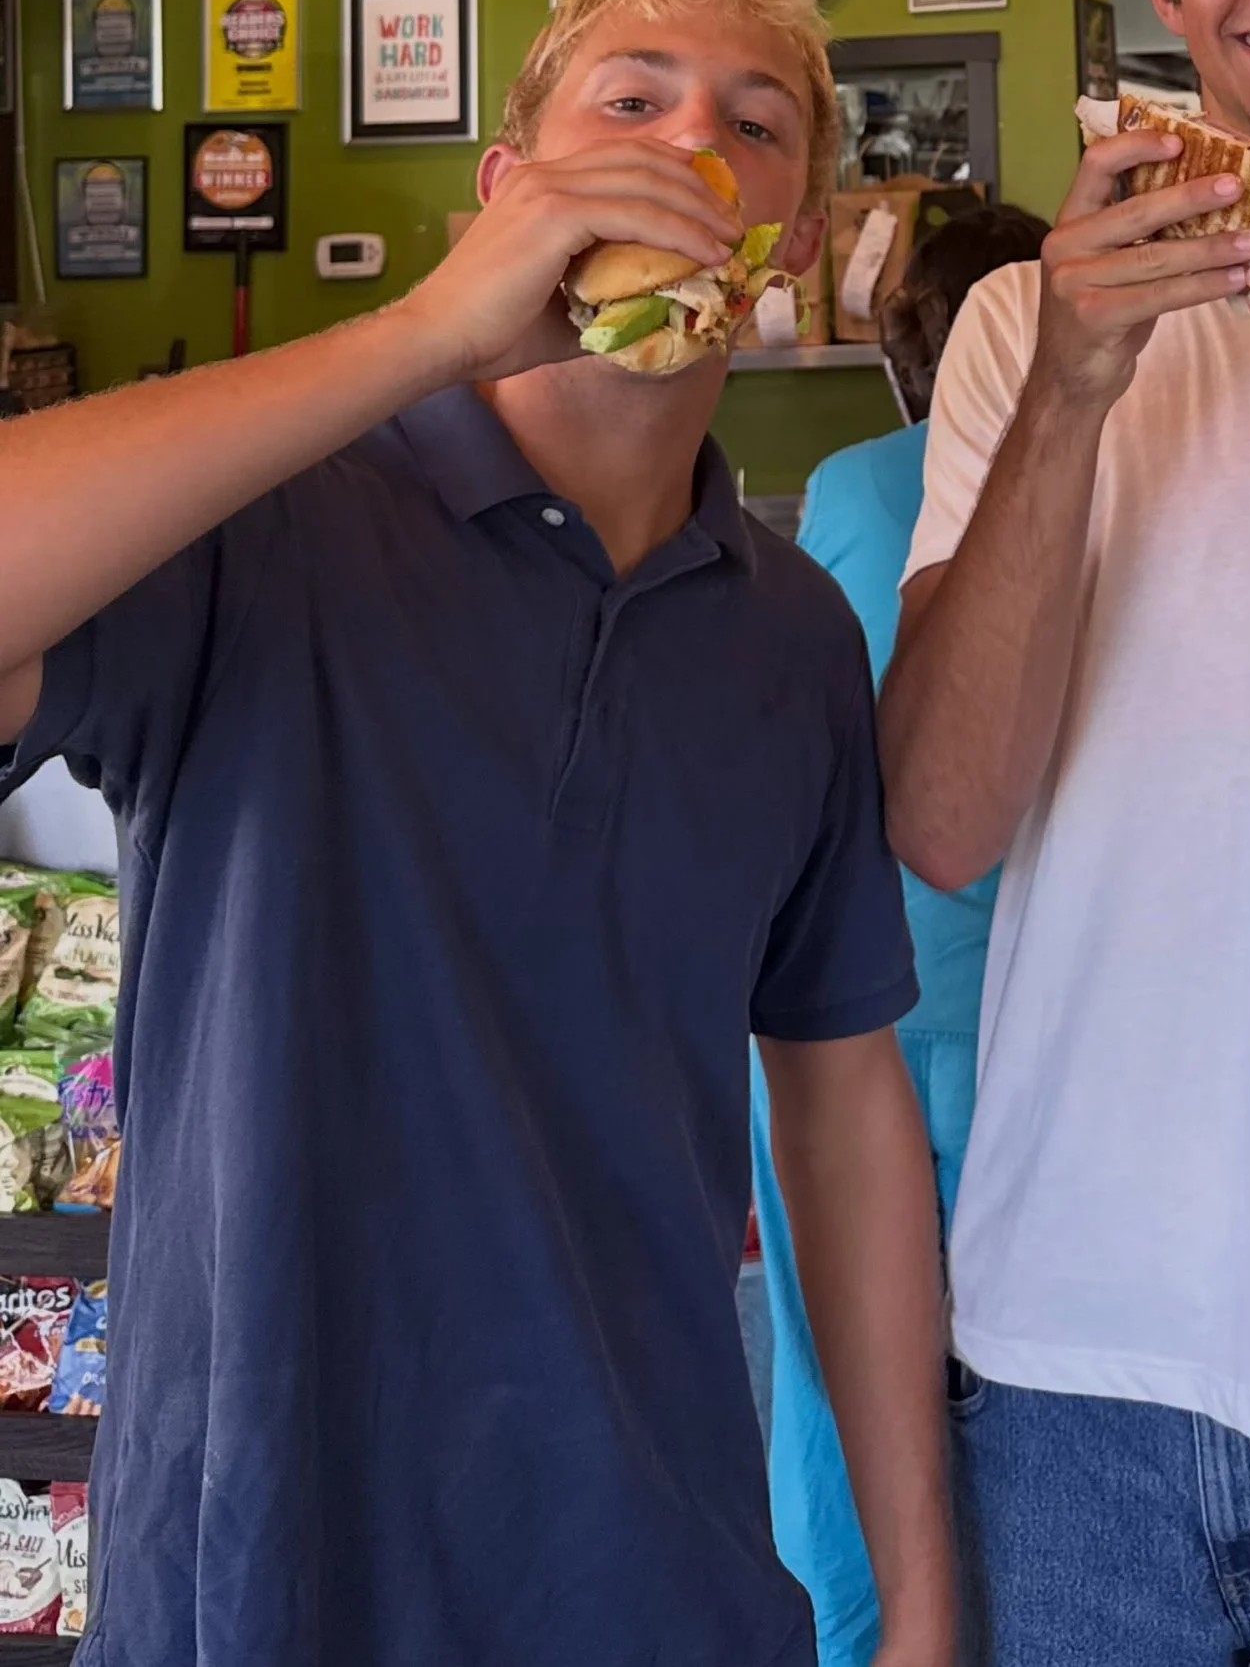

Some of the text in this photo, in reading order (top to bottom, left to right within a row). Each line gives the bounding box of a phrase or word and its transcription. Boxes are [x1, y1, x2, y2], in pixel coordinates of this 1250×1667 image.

[378, 13, 444, 39] WORK
[379, 41, 443, 67] HARD
[0, 1286, 71, 1314] ritos
[14, 1534, 46, 1554] SALT
